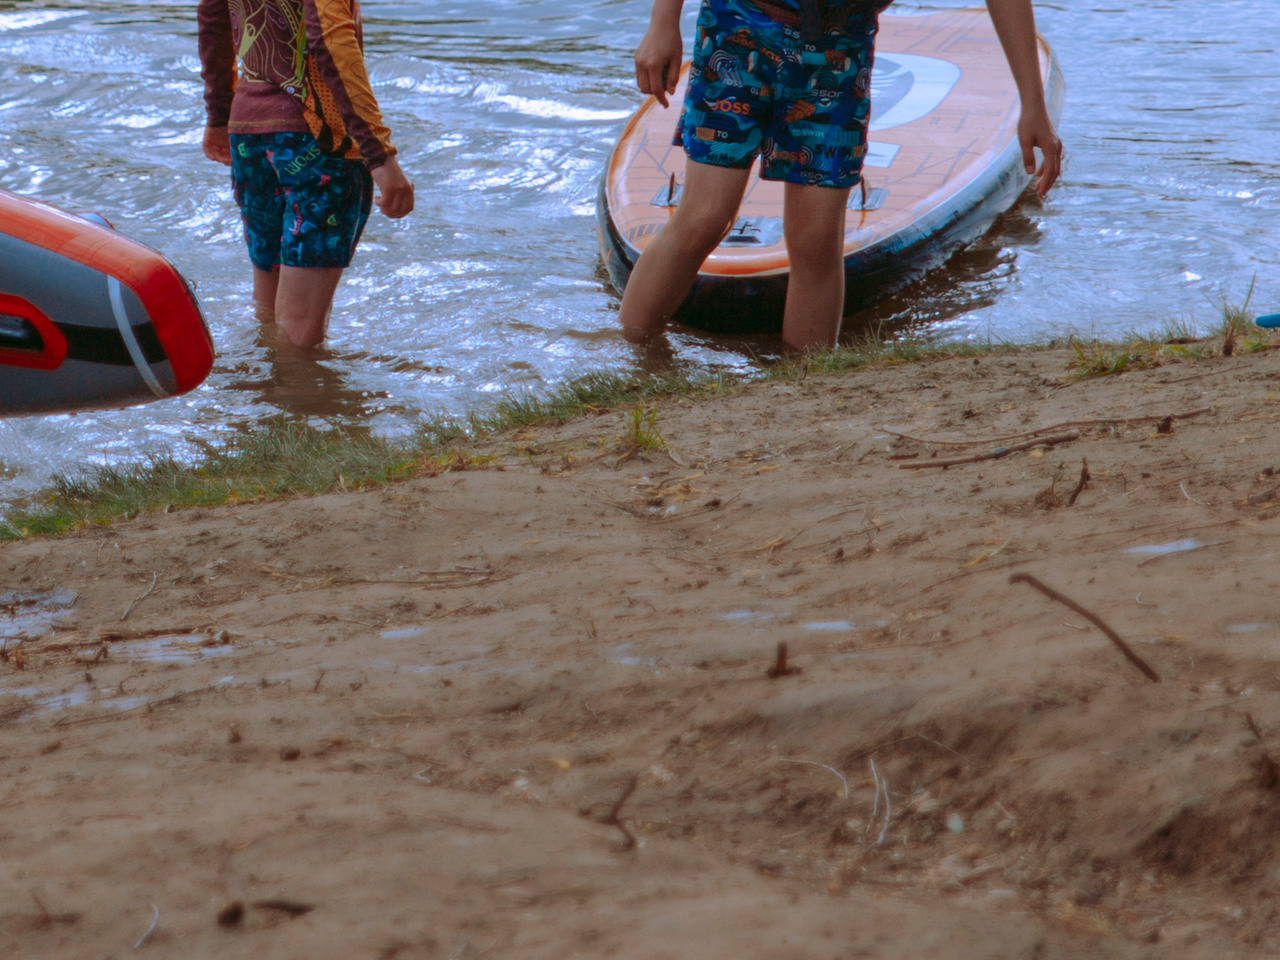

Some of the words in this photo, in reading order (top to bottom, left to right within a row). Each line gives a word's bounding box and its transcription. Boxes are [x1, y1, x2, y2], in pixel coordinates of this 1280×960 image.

[805, 44, 816, 52] TO
[711, 100, 750, 115] JOSS
[717, 130, 729, 138] TO
